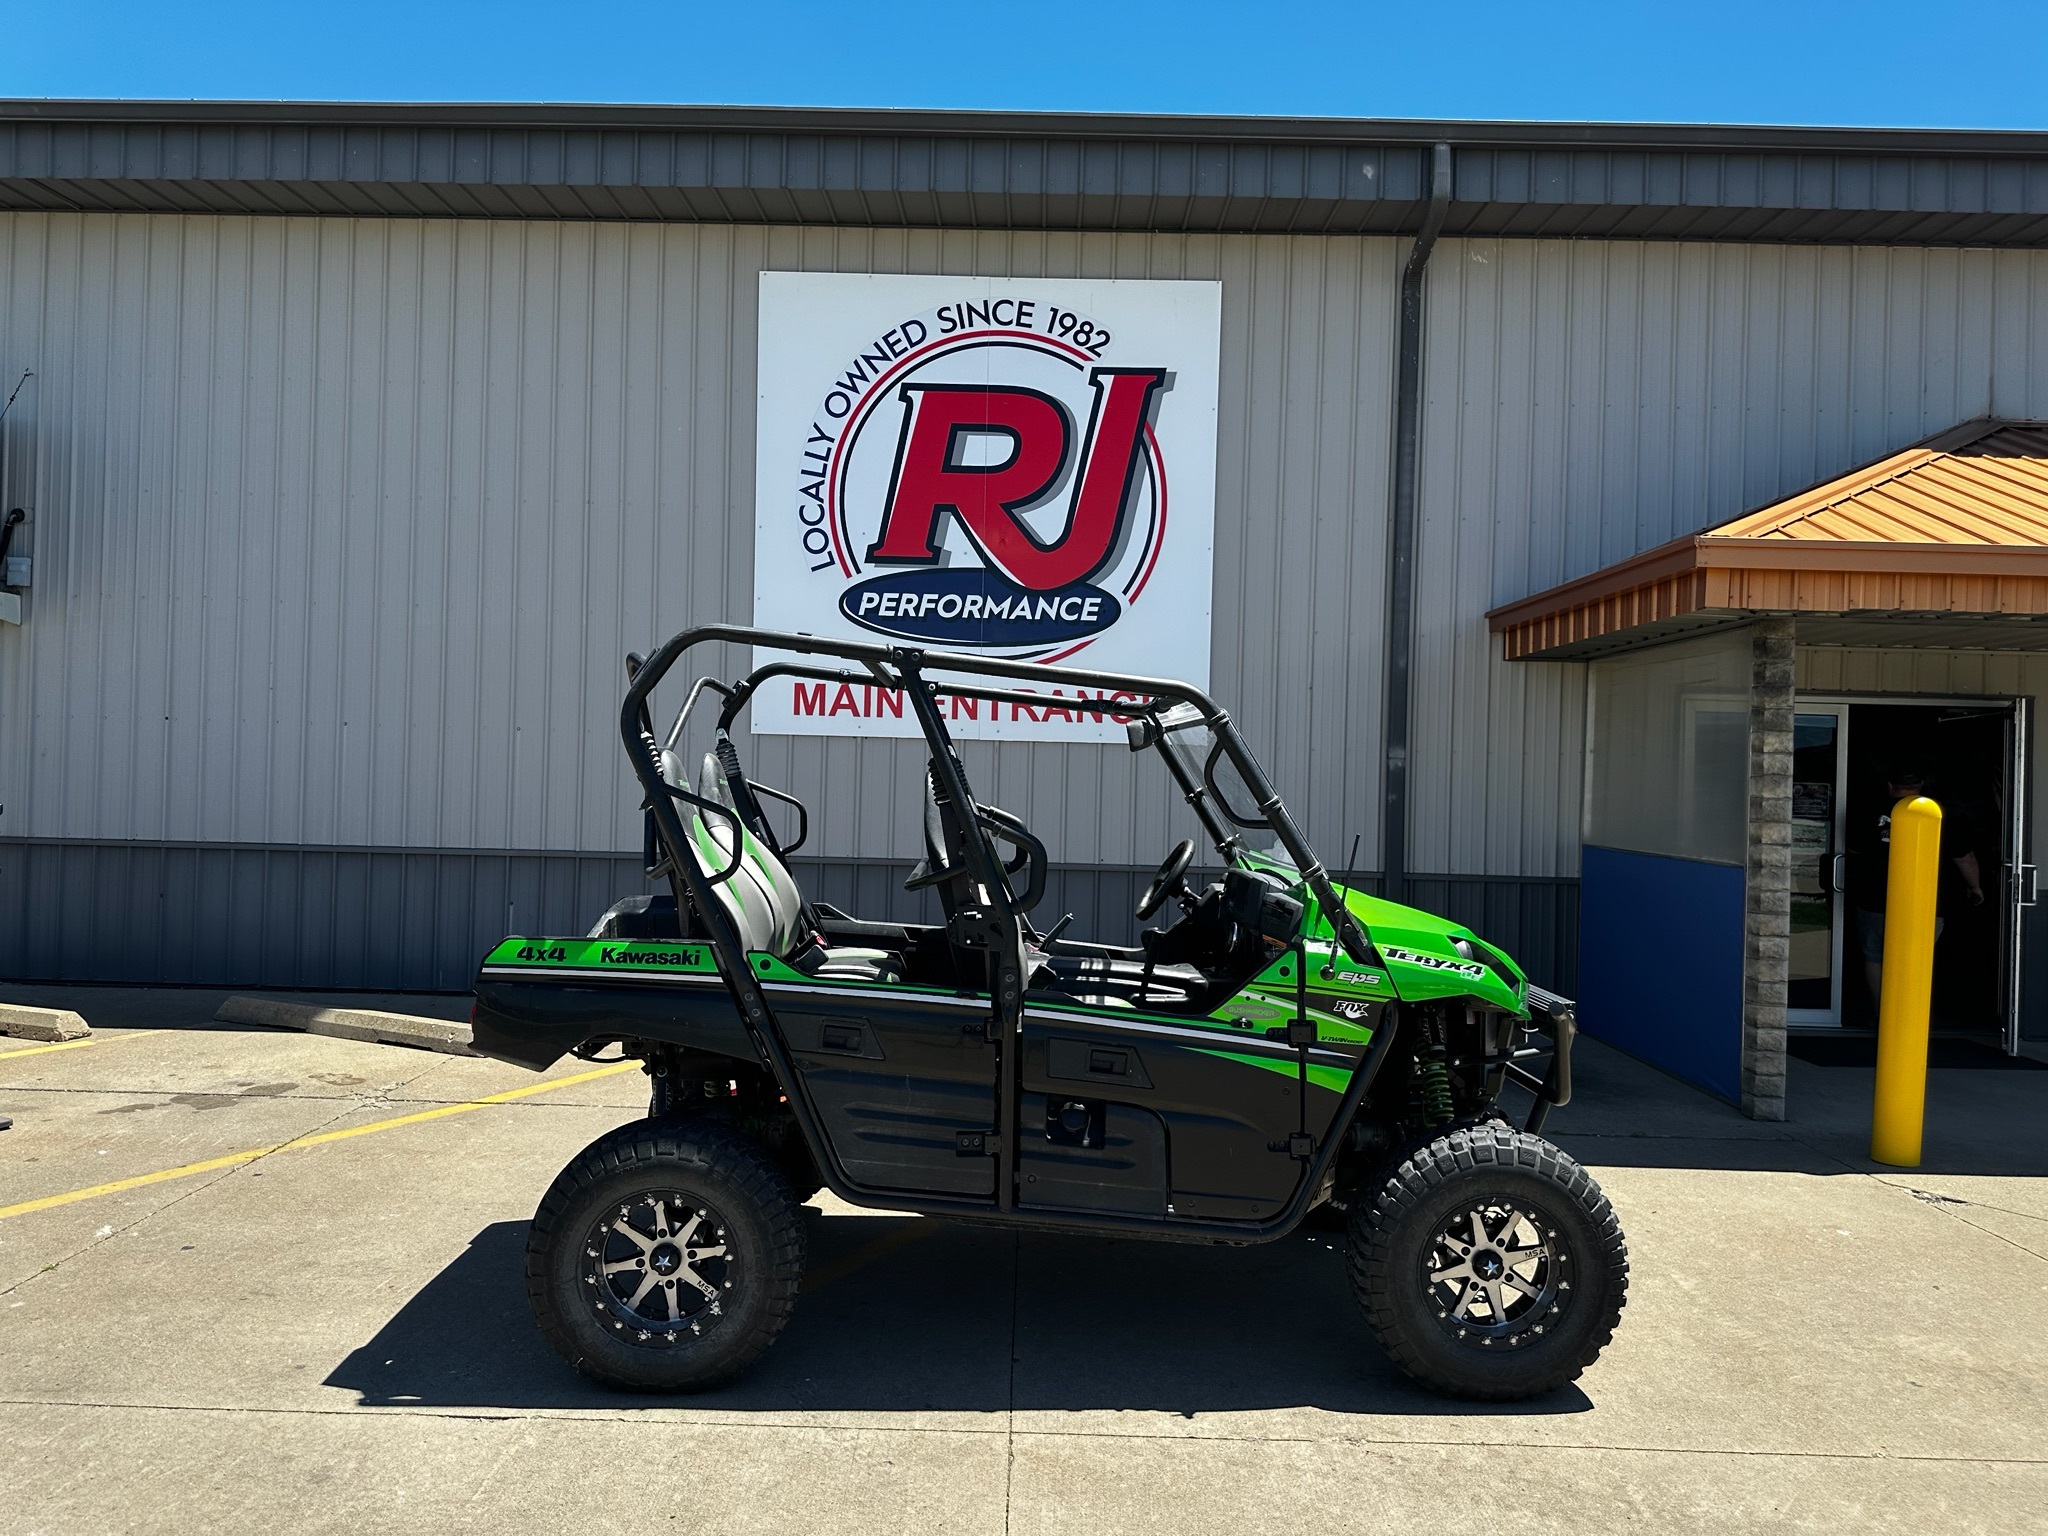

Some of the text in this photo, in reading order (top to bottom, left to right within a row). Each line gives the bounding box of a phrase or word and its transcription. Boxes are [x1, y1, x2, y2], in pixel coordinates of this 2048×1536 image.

[799, 299, 1111, 573] LOCALLY OWNED SINCE 1982
[864, 367, 1168, 592] RJ
[857, 591, 1102, 623] PERFORMANCE
[793, 682, 904, 719] MAIN
[516, 946, 567, 962] 4x4
[600, 946, 701, 966] Kawasaki
[1525, 1248, 1546, 1259] MSA
[696, 1280, 715, 1297] MSA
